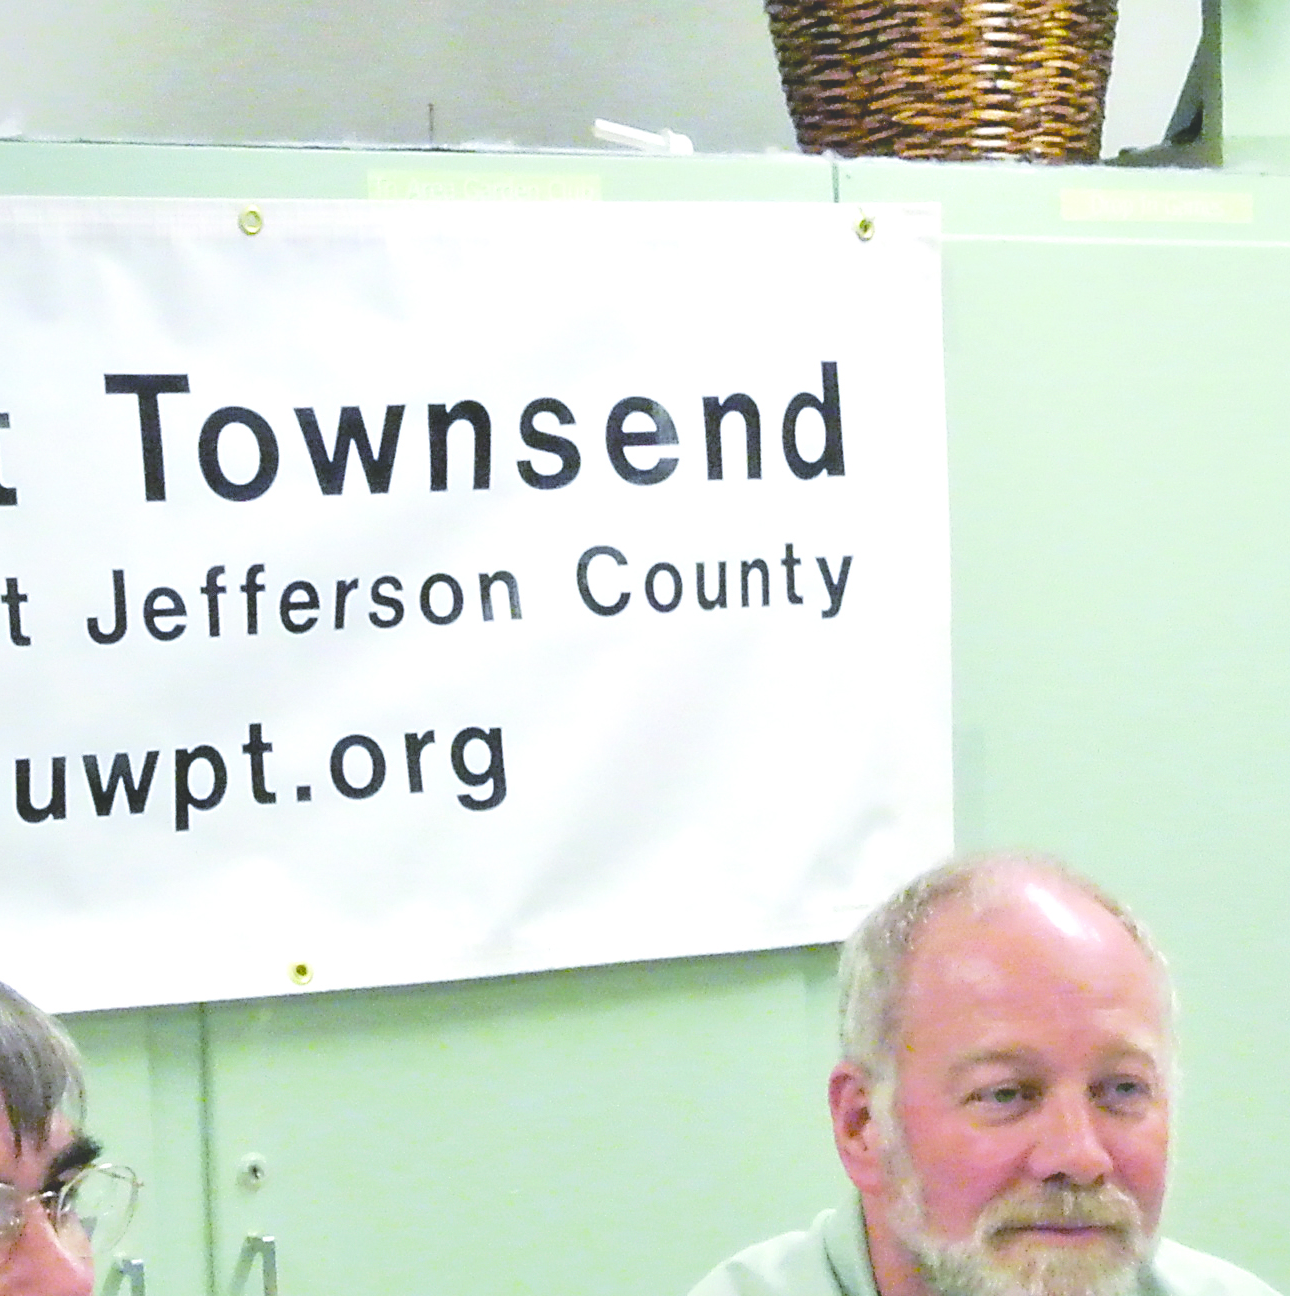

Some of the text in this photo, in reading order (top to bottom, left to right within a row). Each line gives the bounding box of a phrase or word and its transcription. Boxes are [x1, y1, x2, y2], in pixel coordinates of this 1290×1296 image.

[103, 361, 846, 503] Townsend
[86, 563, 523, 645] Jefferson
[576, 543, 853, 619] County
